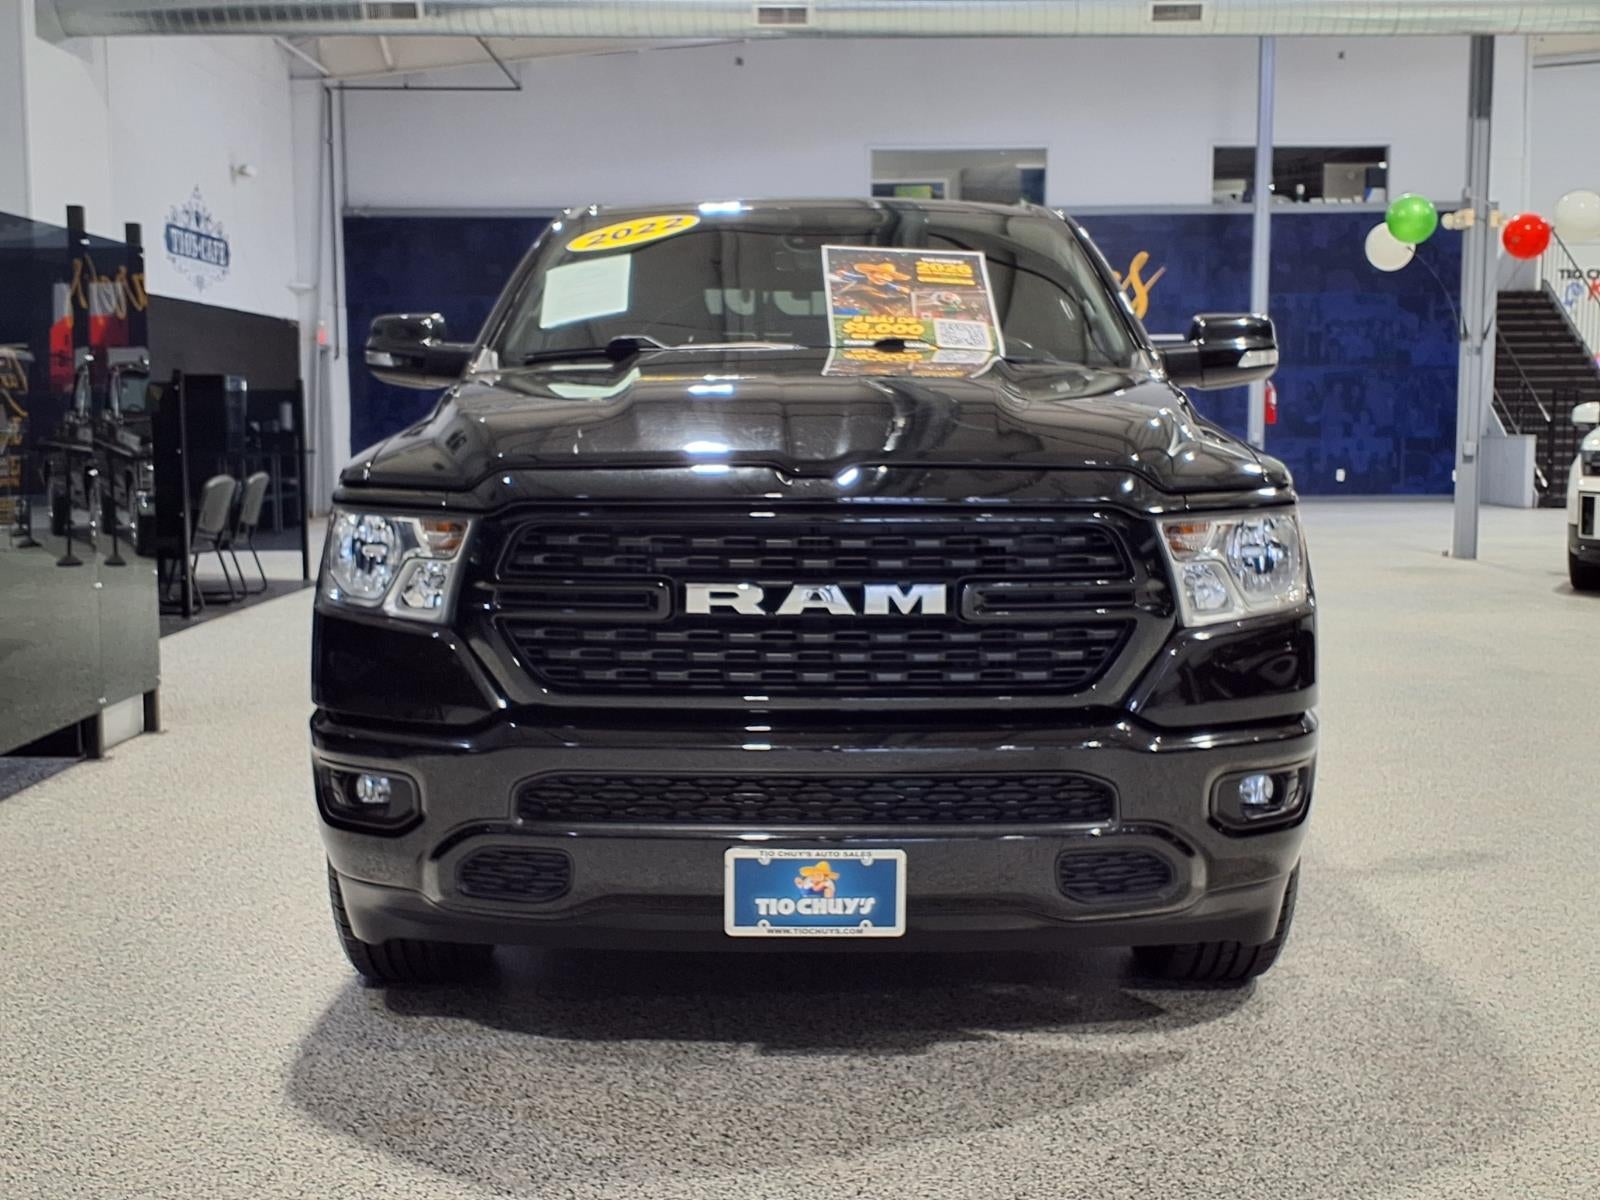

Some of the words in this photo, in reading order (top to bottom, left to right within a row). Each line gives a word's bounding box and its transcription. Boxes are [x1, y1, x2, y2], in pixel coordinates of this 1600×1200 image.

[584, 217, 685, 248] 2022
[685, 583, 947, 615] RAM
[760, 850, 774, 858] TIO
[777, 850, 812, 858] CHUY'S
[815, 850, 840, 858] AUTO
[842, 850, 873, 858] SALES
